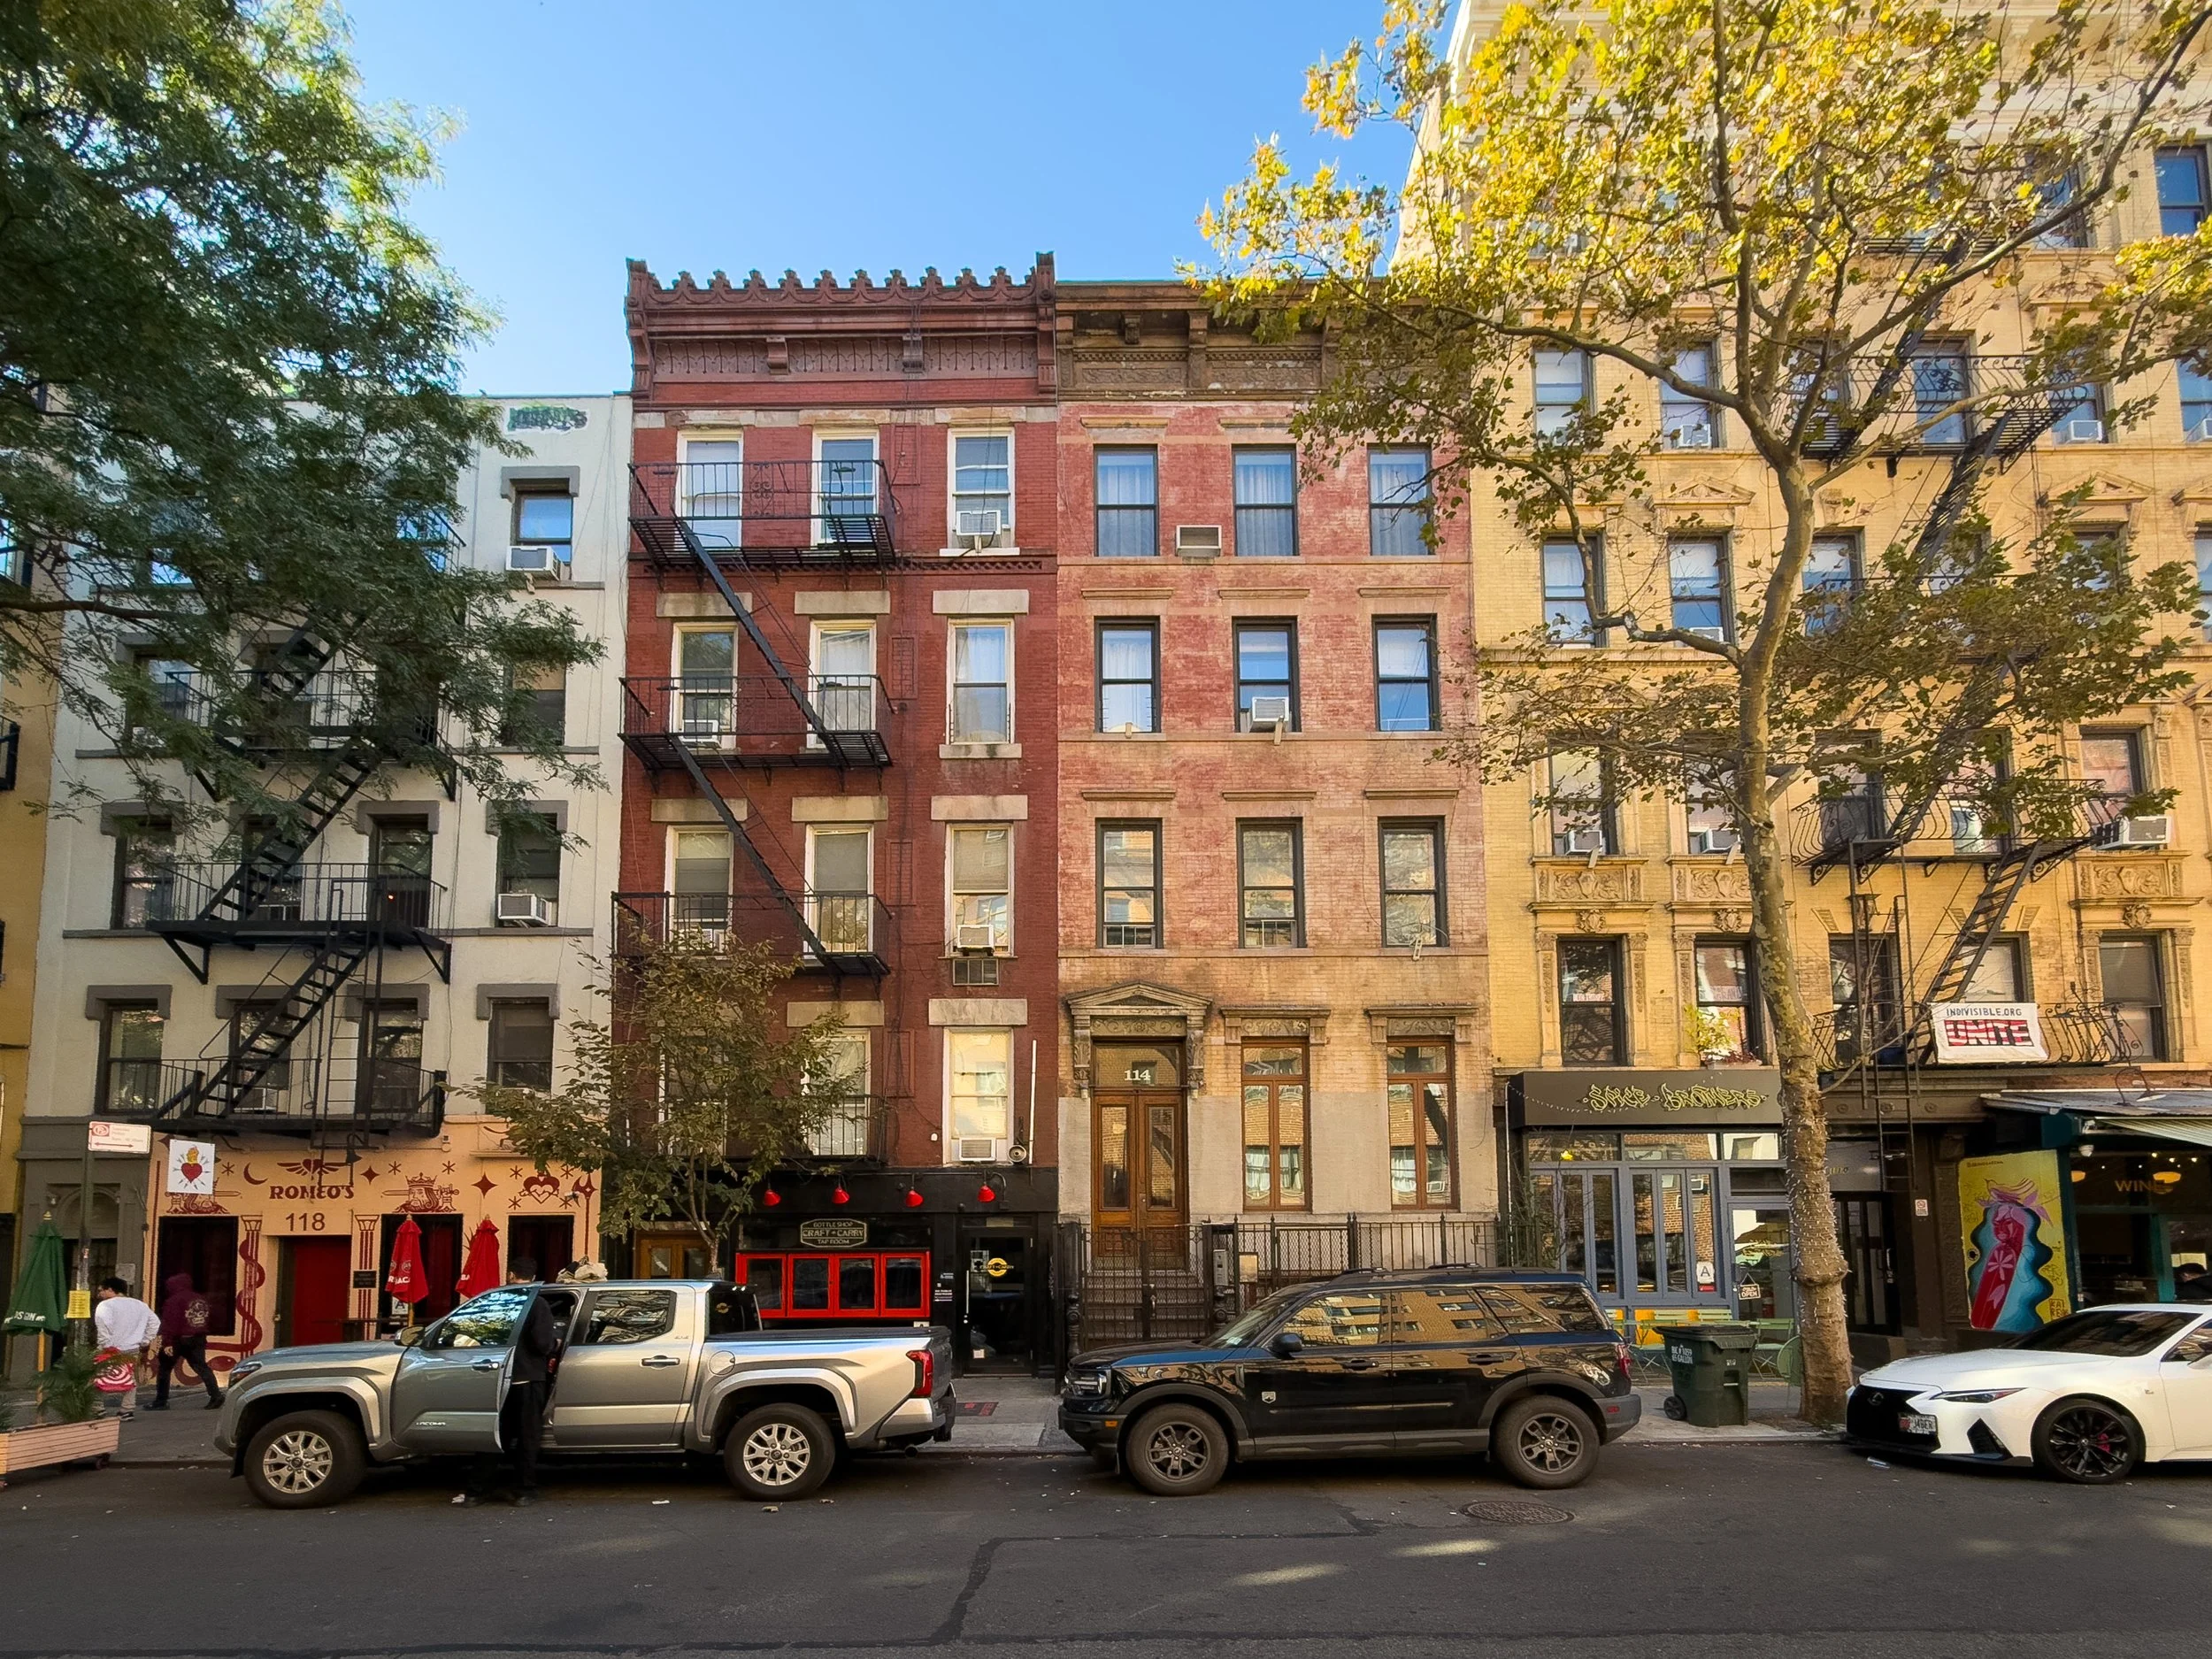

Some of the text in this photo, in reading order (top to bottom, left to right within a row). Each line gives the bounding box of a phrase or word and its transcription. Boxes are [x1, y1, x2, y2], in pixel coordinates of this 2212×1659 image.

[1946, 1008, 2023, 1017] INDIVISIBLE.ORG
[1944, 1019, 2035, 1047] UNITE
[1124, 1069, 1151, 1081] 114
[1660, 1082, 1762, 1111] BROTHERS
[269, 1186, 354, 1199] ROMEO'S
[285, 1212, 326, 1231] 118
[1701, 1266, 1710, 1277] A
